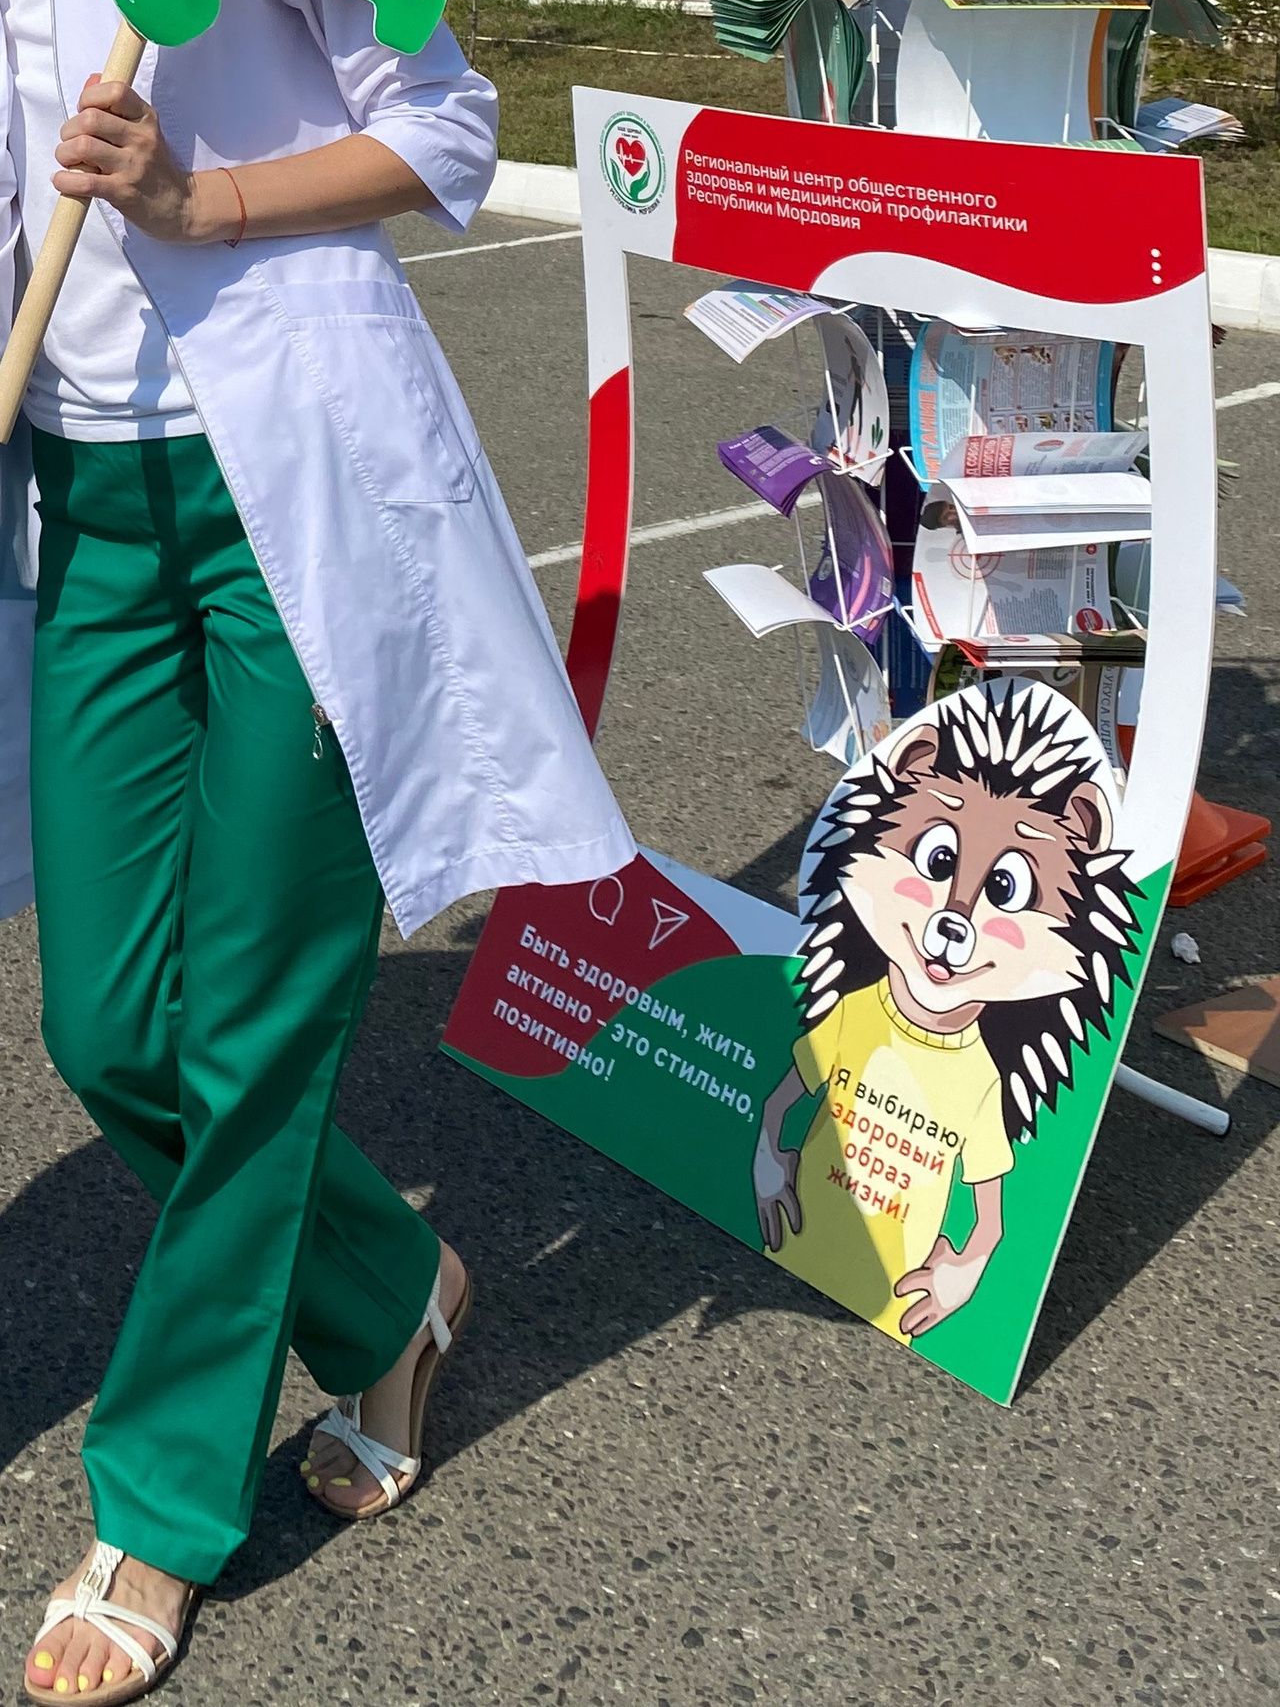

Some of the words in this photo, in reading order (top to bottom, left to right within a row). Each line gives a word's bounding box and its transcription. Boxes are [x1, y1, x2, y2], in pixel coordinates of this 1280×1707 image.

[684, 149, 789, 182] Региональный
[793, 170, 844, 193] центр
[848, 177, 998, 210] общественного
[686, 170, 753, 194] здоровья
[757, 183, 766, 196] и
[770, 185, 883, 215] медицинской
[886, 202, 1028, 233] профилактики
[687, 185, 773, 216] Республики
[776, 201, 861, 230] Мордовия
[982, 439, 996, 476] ЛКОГОЛЬ
[1100, 675, 1114, 714] УКУСА
[520, 923, 570, 970] Быть
[574, 958, 688, 1038] здоровым,
[695, 1023, 757, 1071] жить
[493, 999, 616, 1082] позитивно!
[506, 964, 592, 1024] активно
[611, 1023, 650, 1057] это
[654, 1048, 755, 1123] стильно,
[831, 1101, 946, 1176] здоровый
[834, 1068, 852, 1091] Я
[855, 1082, 959, 1149] выбираю
[827, 1165, 911, 1224] жизни!
[845, 1142, 912, 1191] образ
